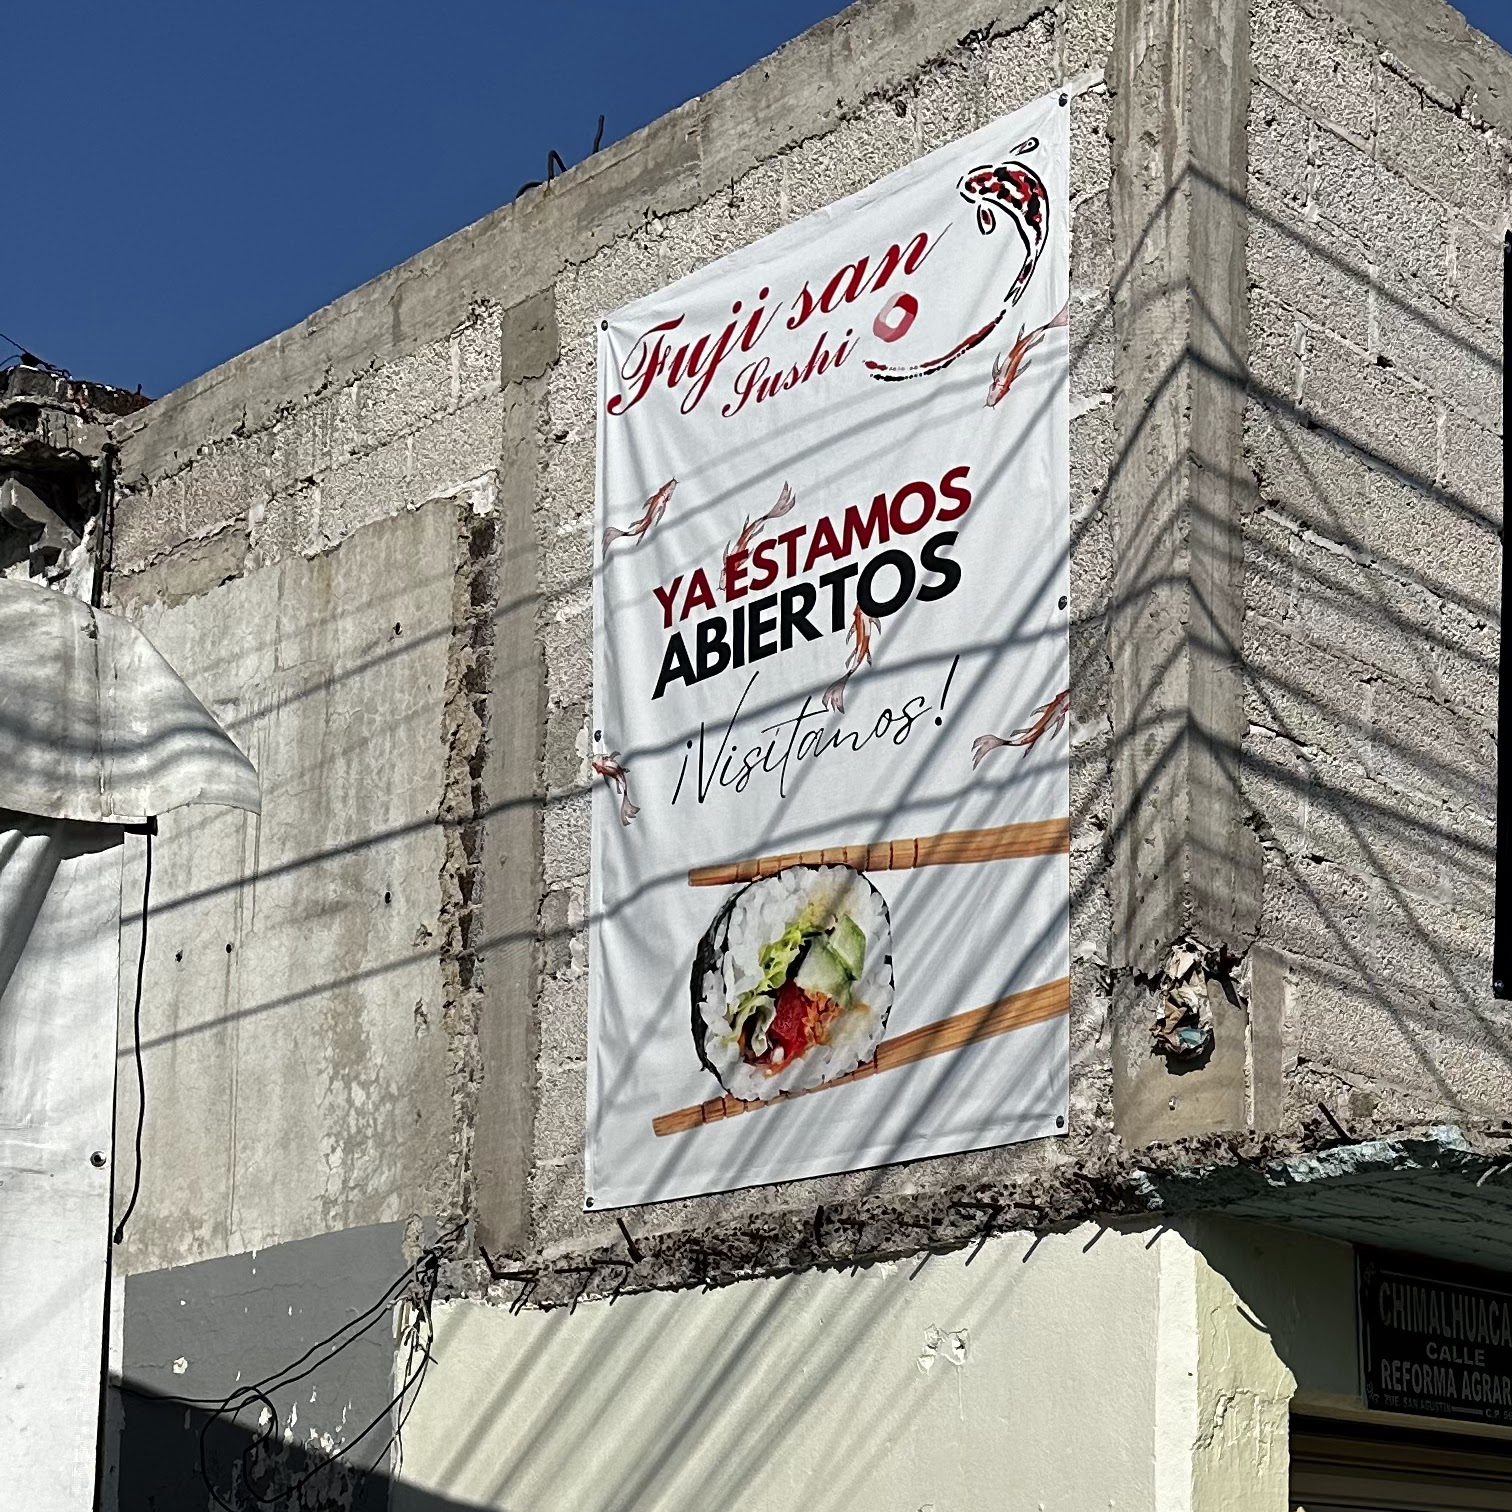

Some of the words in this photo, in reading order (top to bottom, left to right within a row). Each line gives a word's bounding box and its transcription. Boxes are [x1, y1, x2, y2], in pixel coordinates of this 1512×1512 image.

[607, 287, 783, 415] Fuji
[786, 222, 953, 329] san
[722, 328, 860, 417] Sushi
[653, 568, 714, 629] YA
[725, 466, 972, 600] ESTAMOS
[652, 531, 961, 700] ABIERTOS
[1381, 1358, 1458, 1399] REFORMA
[1425, 1342, 1486, 1367] CALLE
